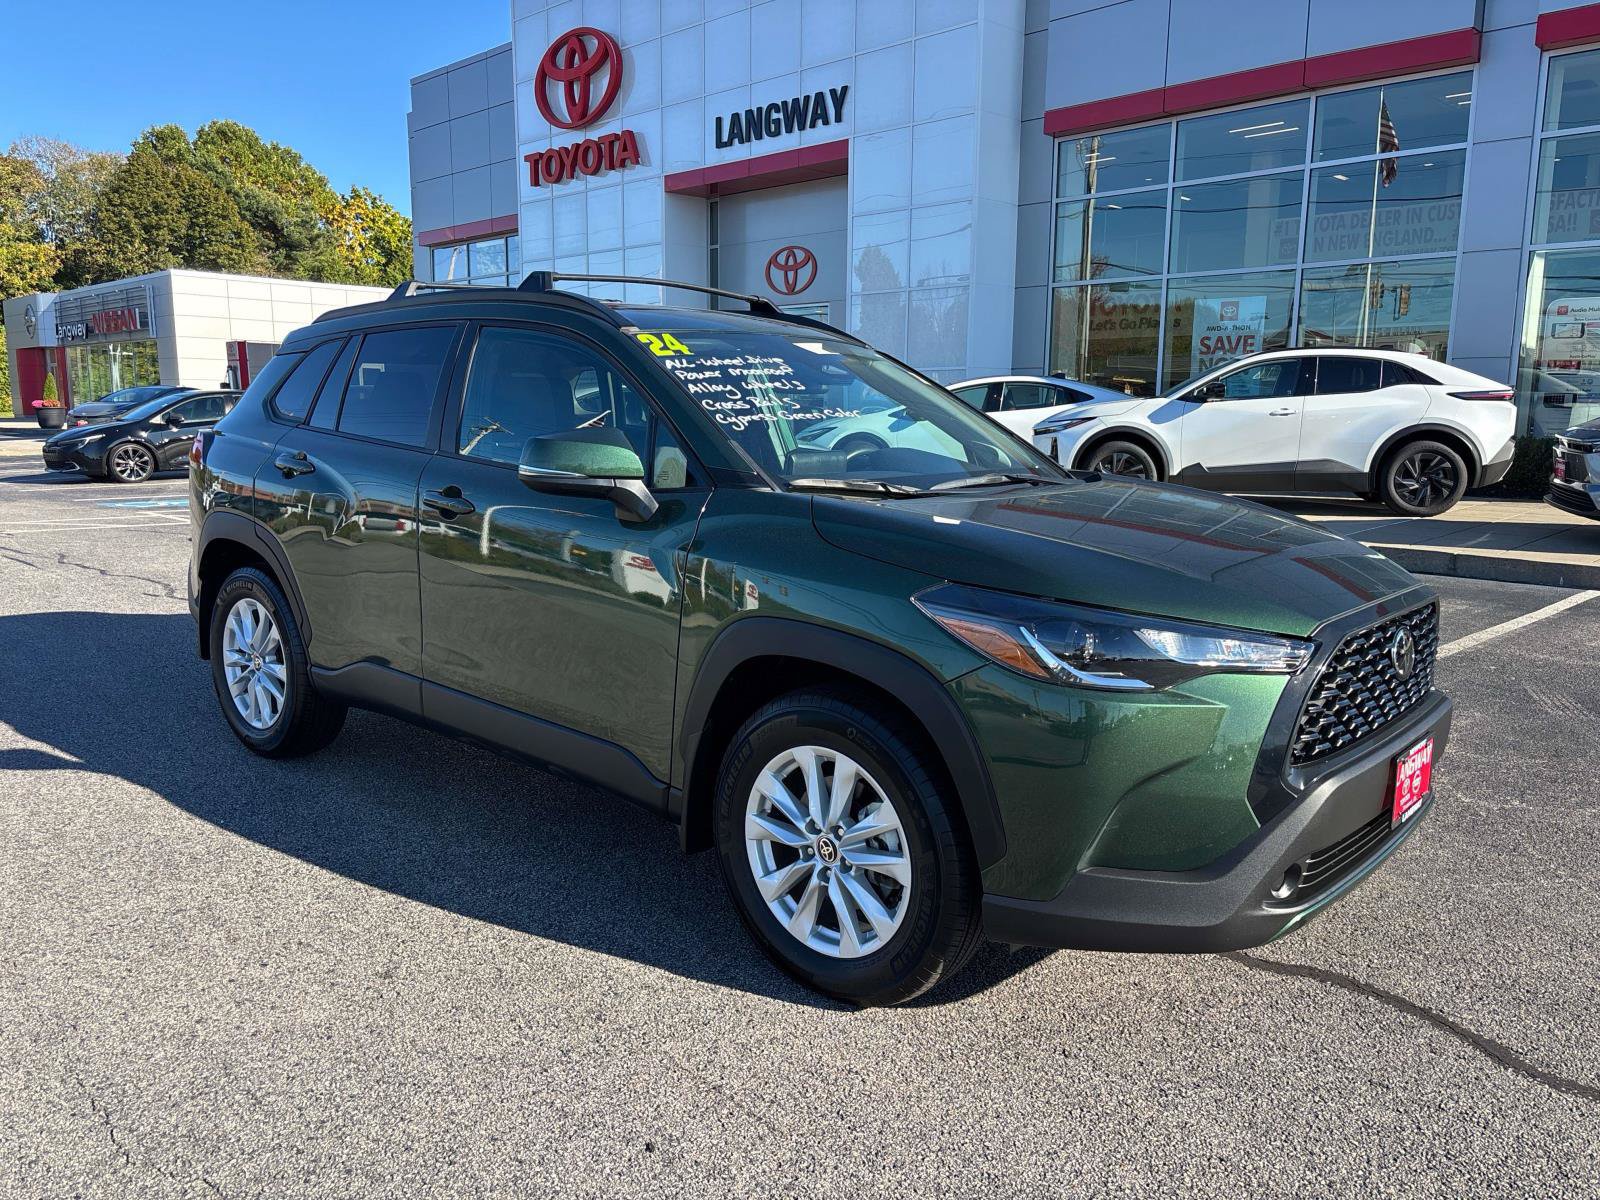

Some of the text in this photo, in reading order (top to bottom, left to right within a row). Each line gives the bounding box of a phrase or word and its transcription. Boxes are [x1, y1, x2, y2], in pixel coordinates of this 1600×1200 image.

[715, 85, 848, 149] LANGWAY
[524, 130, 640, 187] TOYOTA
[1350, 207, 1400, 229] DELER
[56, 308, 140, 341] Langway NISSAN
[1089, 317, 1182, 331] Let's Go Plas
[636, 333, 694, 356] 24
[1199, 335, 1255, 355] SAVE
[674, 370, 722, 380] Power
[688, 382, 741, 399] Alloy
[701, 394, 800, 410] Cross Rails
[715, 408, 861, 431] Cypress Green Color
[226, 580, 254, 593] MICHELIN
[1396, 741, 1432, 787] LANGWAY
